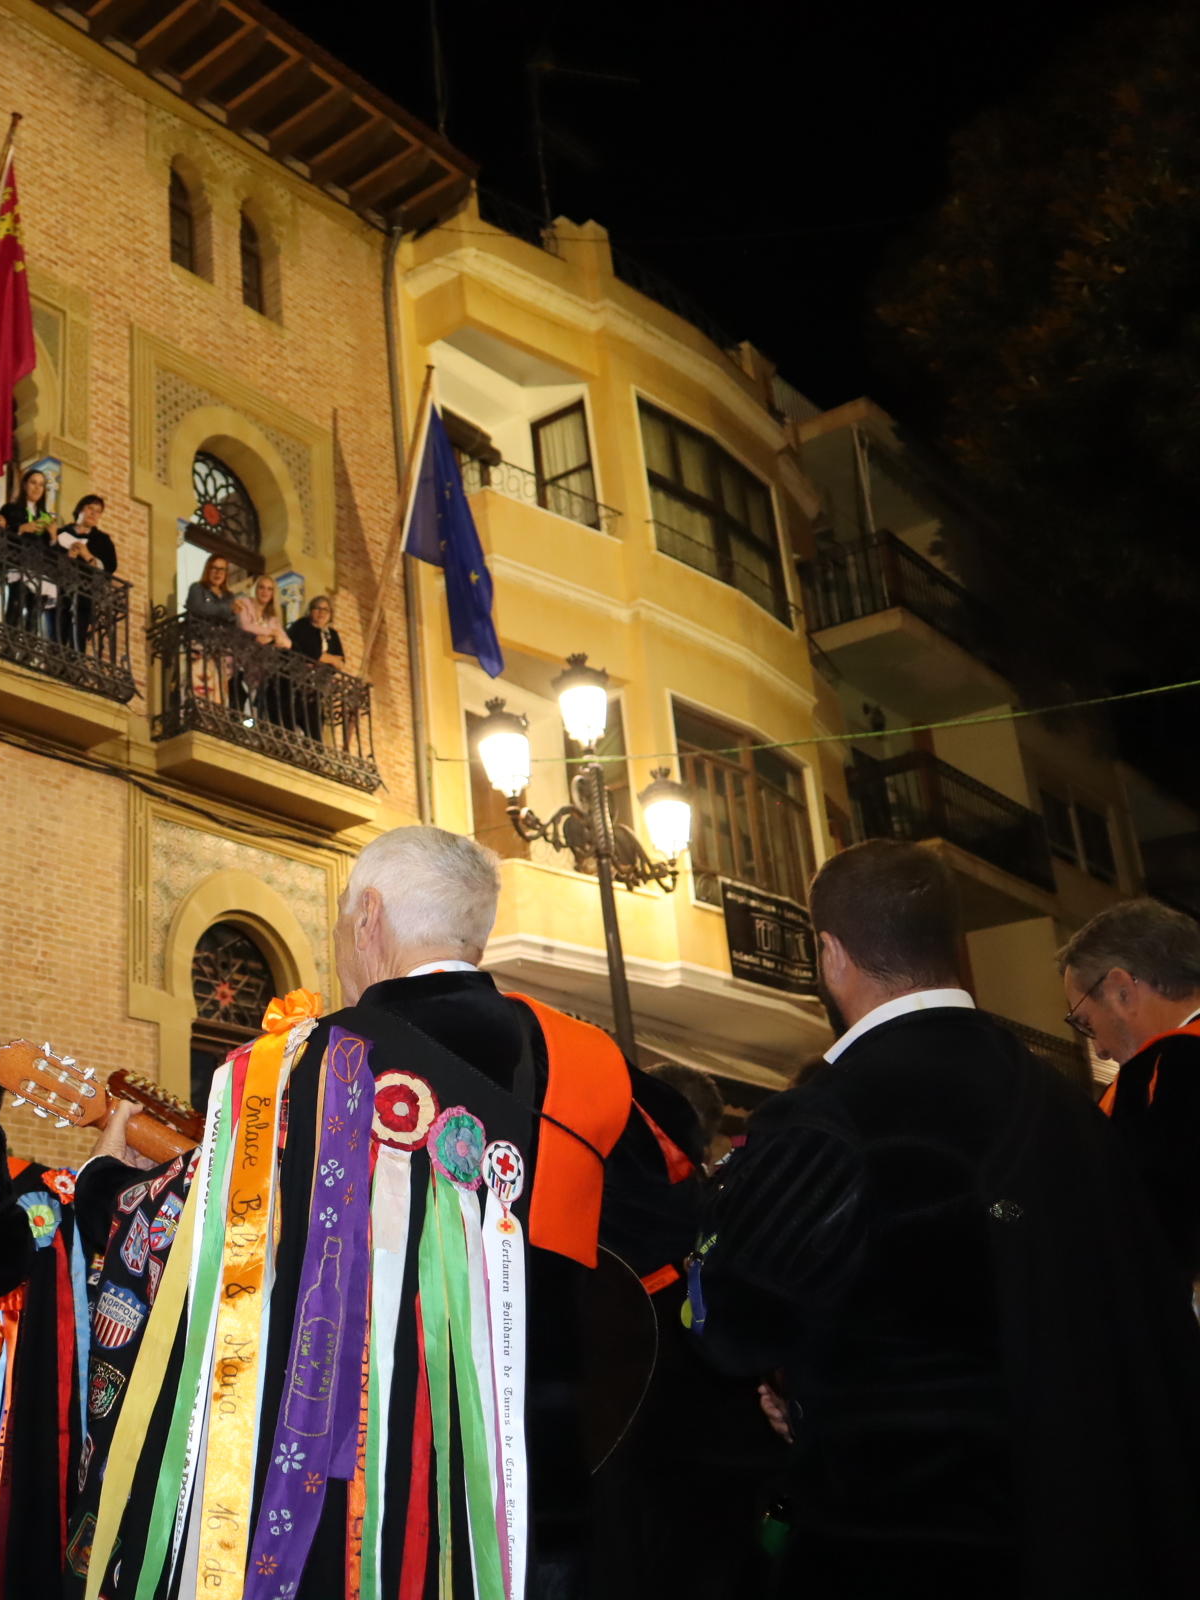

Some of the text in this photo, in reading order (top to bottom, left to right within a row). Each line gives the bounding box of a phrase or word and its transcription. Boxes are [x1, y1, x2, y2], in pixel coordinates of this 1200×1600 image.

[243, 1095, 271, 1170] Enlace
[501, 1239, 512, 1293] Certamen
[225, 1282, 257, 1300] &
[102, 1295, 140, 1325] NORFOLK
[502, 1301, 513, 1357] Solidario
[310, 1360, 321, 1370] A
[503, 1365, 513, 1379] de
[503, 1387, 513, 1426] Tunas
[504, 1435, 514, 1448] de
[505, 1457, 515, 1489] Cruz
[203, 1557, 237, 1590] de
